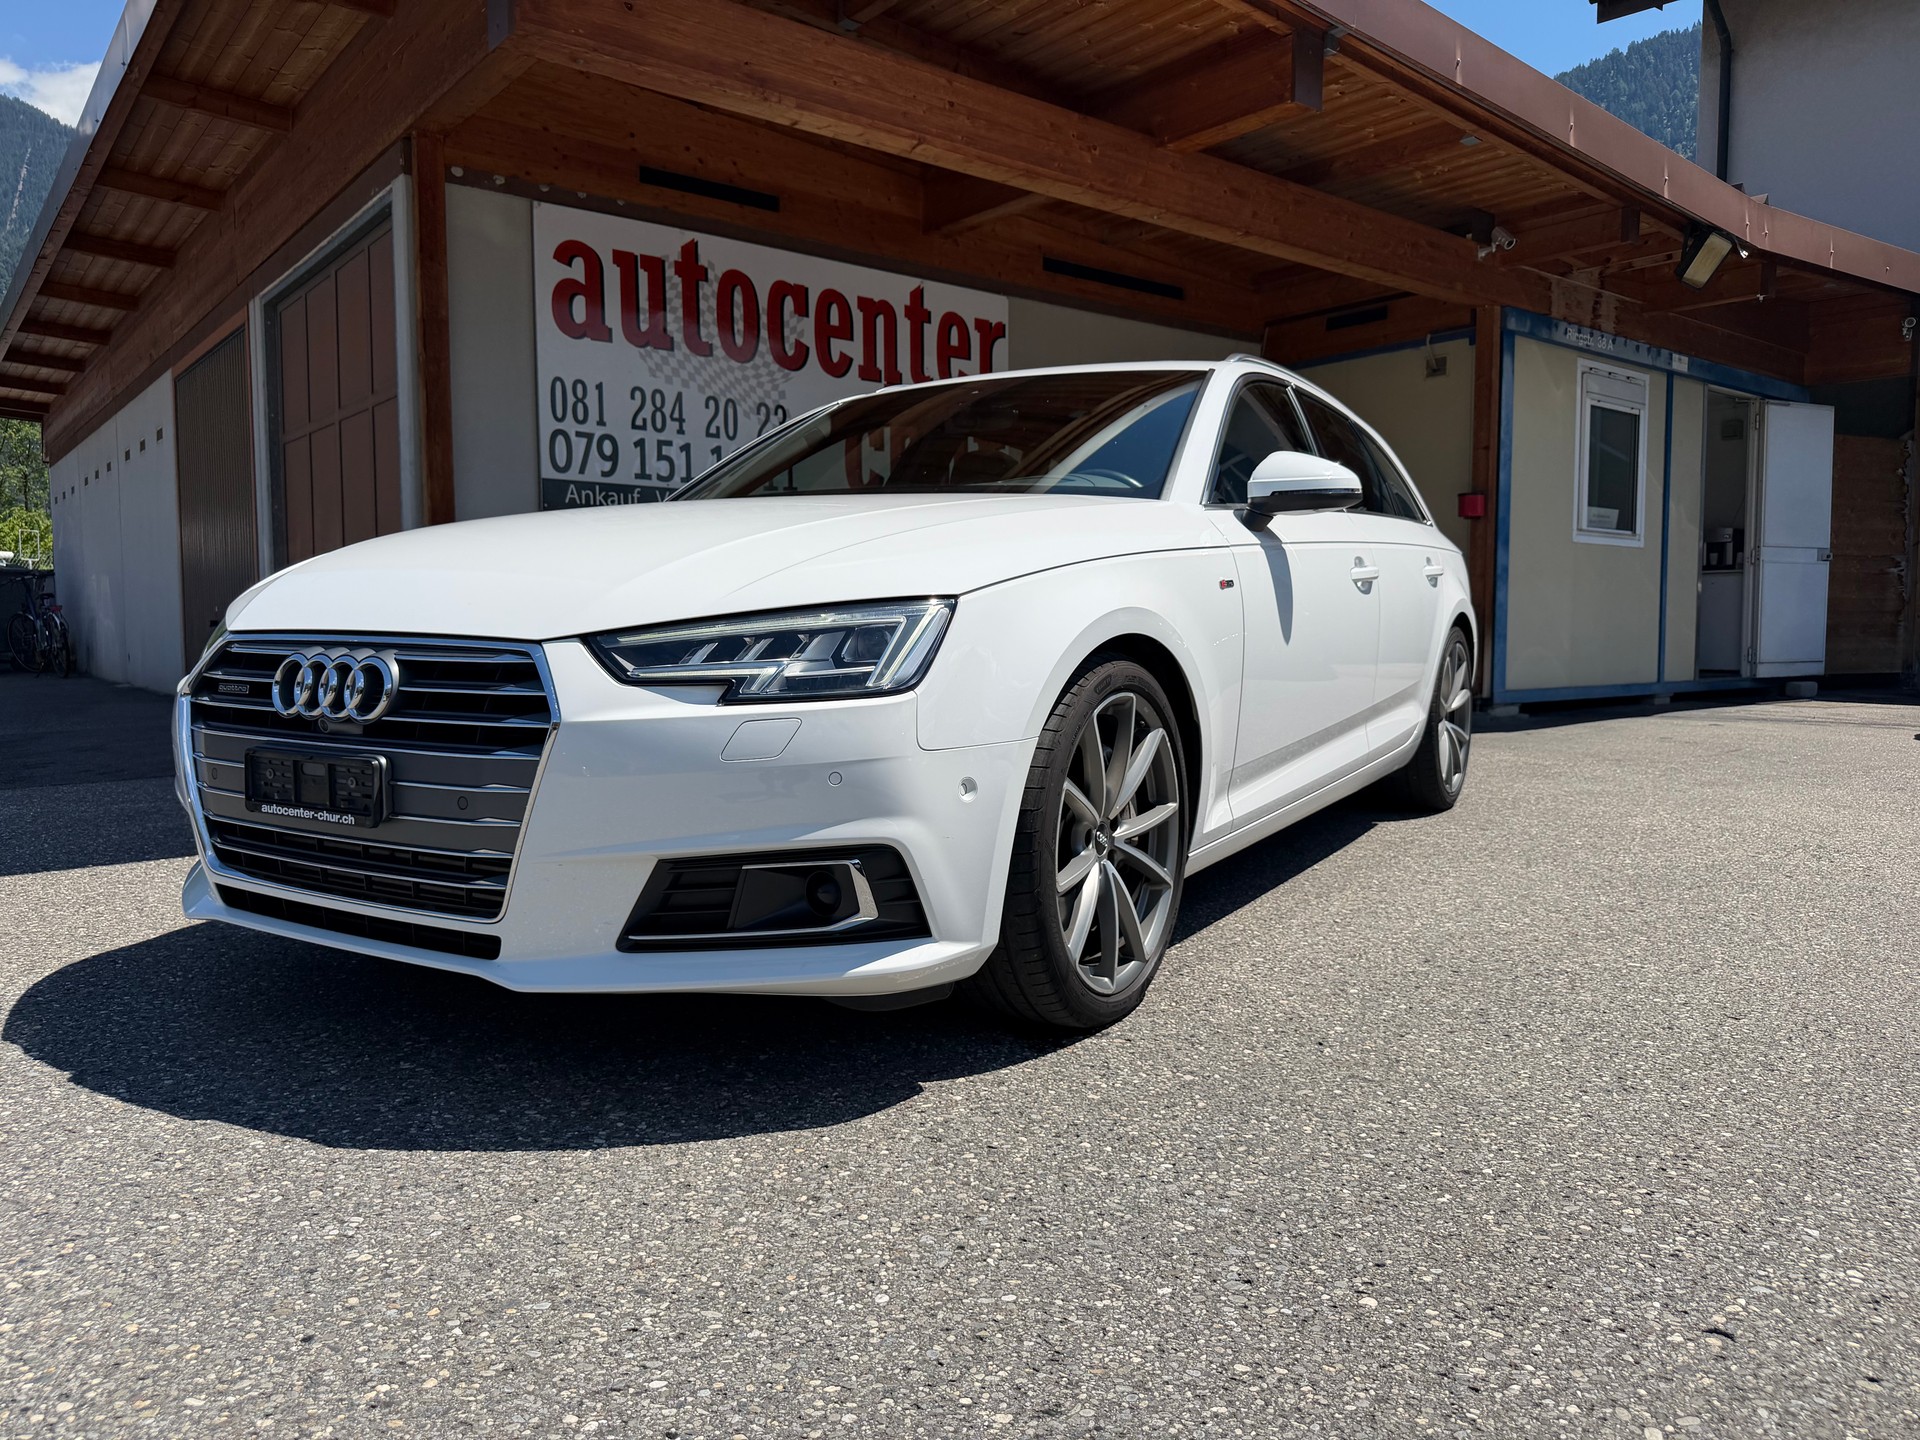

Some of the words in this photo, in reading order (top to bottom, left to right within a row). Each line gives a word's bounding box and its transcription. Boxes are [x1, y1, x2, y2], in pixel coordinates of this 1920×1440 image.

[552, 239, 1006, 386] autocenter
[551, 376, 607, 427] 081
[630, 386, 686, 435] 284
[705, 395, 738, 441] 20
[549, 429, 619, 477] 079
[633, 438, 692, 483] 151
[565, 484, 641, 505] Ankauf
[261, 804, 354, 824] autocenter-chur.ch
